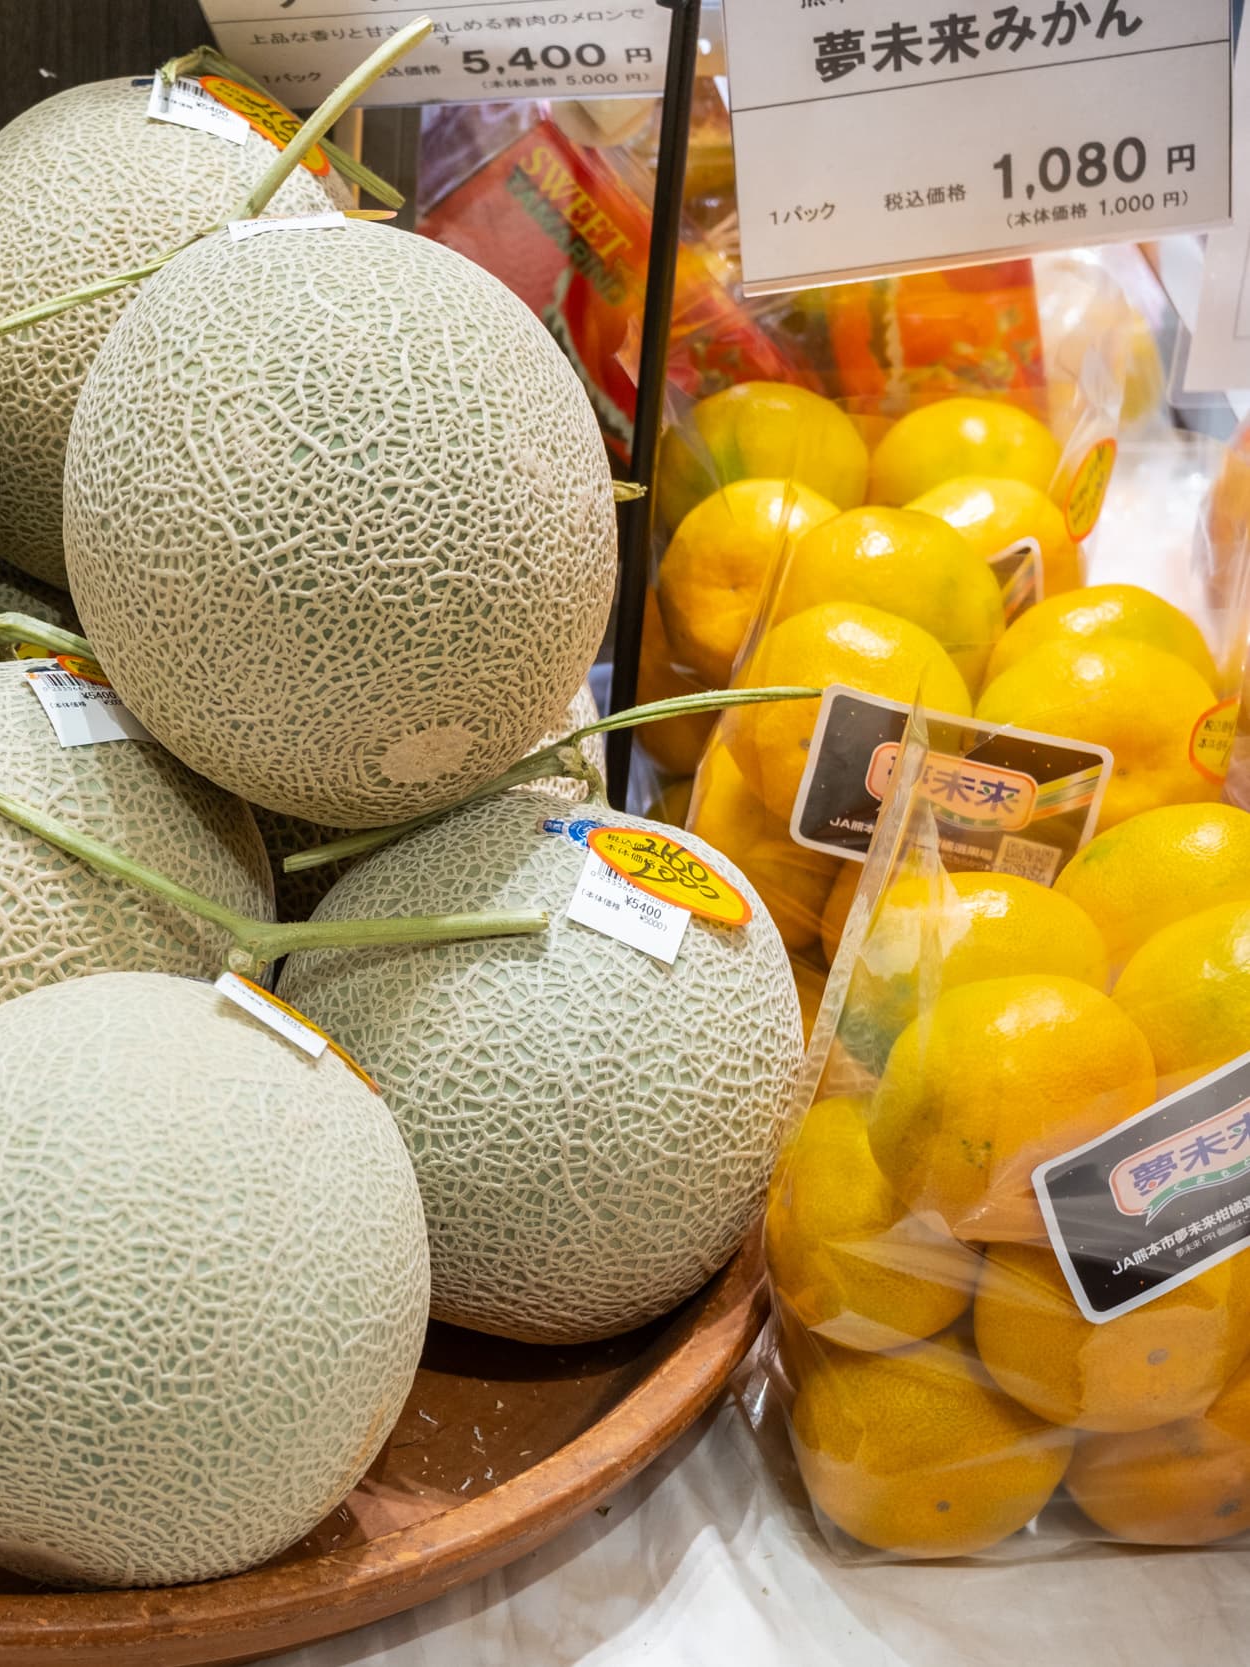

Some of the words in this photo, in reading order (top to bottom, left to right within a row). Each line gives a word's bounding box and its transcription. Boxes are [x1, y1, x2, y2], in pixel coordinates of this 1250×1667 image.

[462, 43, 607, 76] 5,400
[625, 47, 653, 64] 円
[812, 0, 1144, 84] 夢未来みかん
[262, 71, 321, 84] 1パック
[378, 65, 441, 79] 込価格
[482, 77, 556, 89] (本体価格
[625, 71, 650, 84] 円)
[993, 136, 1148, 200] 1,080
[1166, 144, 1197, 174] 円
[519, 145, 633, 259] SWEET
[768, 202, 837, 226] 1パック
[883, 183, 967, 212] 税込価格
[1005, 203, 1089, 230] (本体価格
[1098, 193, 1155, 217] 1,000
[1161, 189, 1190, 210] 円)
[624, 894, 663, 920] ¥5400
